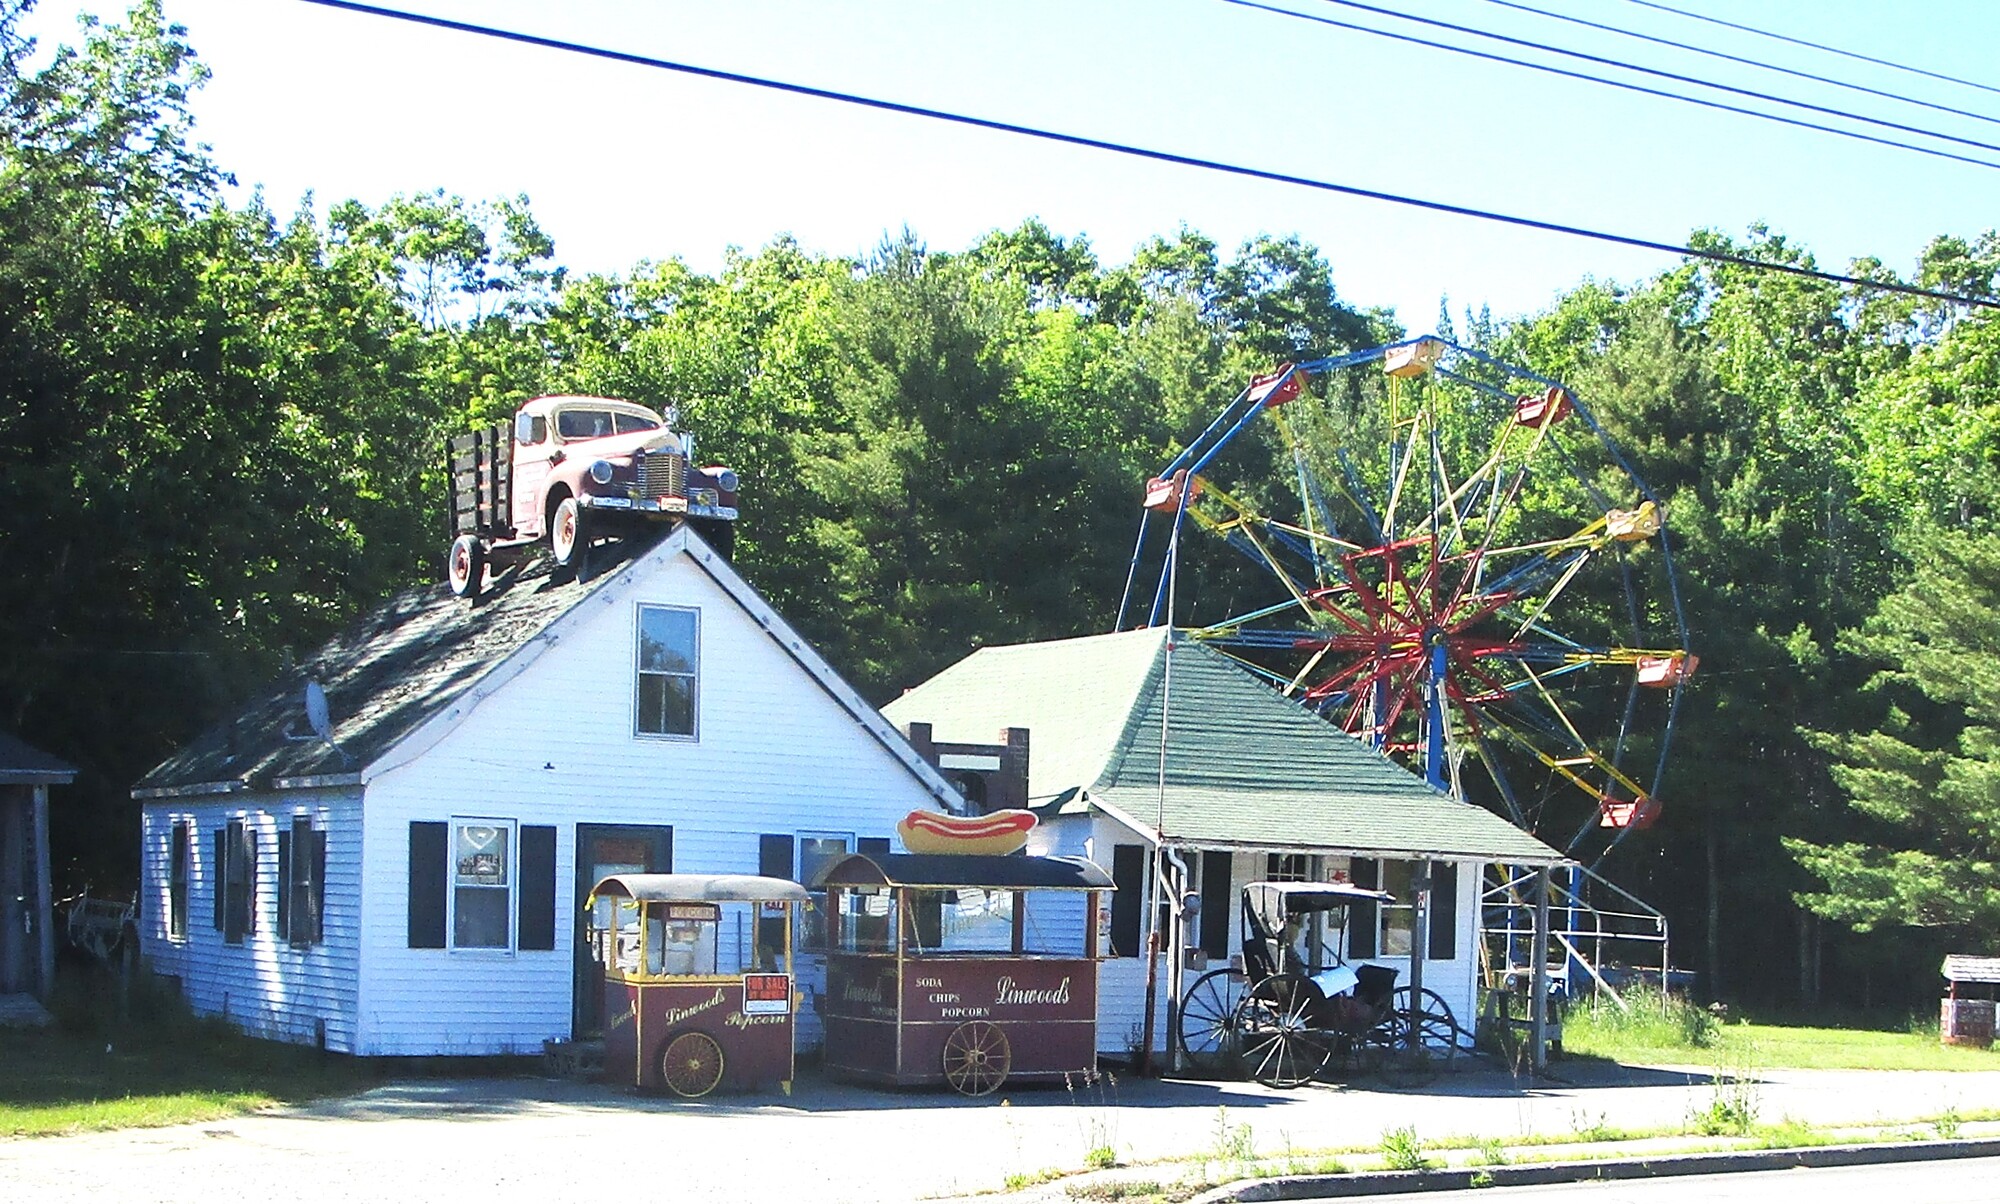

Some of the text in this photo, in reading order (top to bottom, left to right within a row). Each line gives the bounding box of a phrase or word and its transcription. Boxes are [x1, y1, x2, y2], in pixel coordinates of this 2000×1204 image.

[747, 976, 787, 990] FOR SALE
[915, 977, 943, 988] SODA
[929, 993, 961, 1003] CHIPS
[941, 1007, 990, 1017] POPCORN
[724, 1010, 787, 1030] Popcorn
